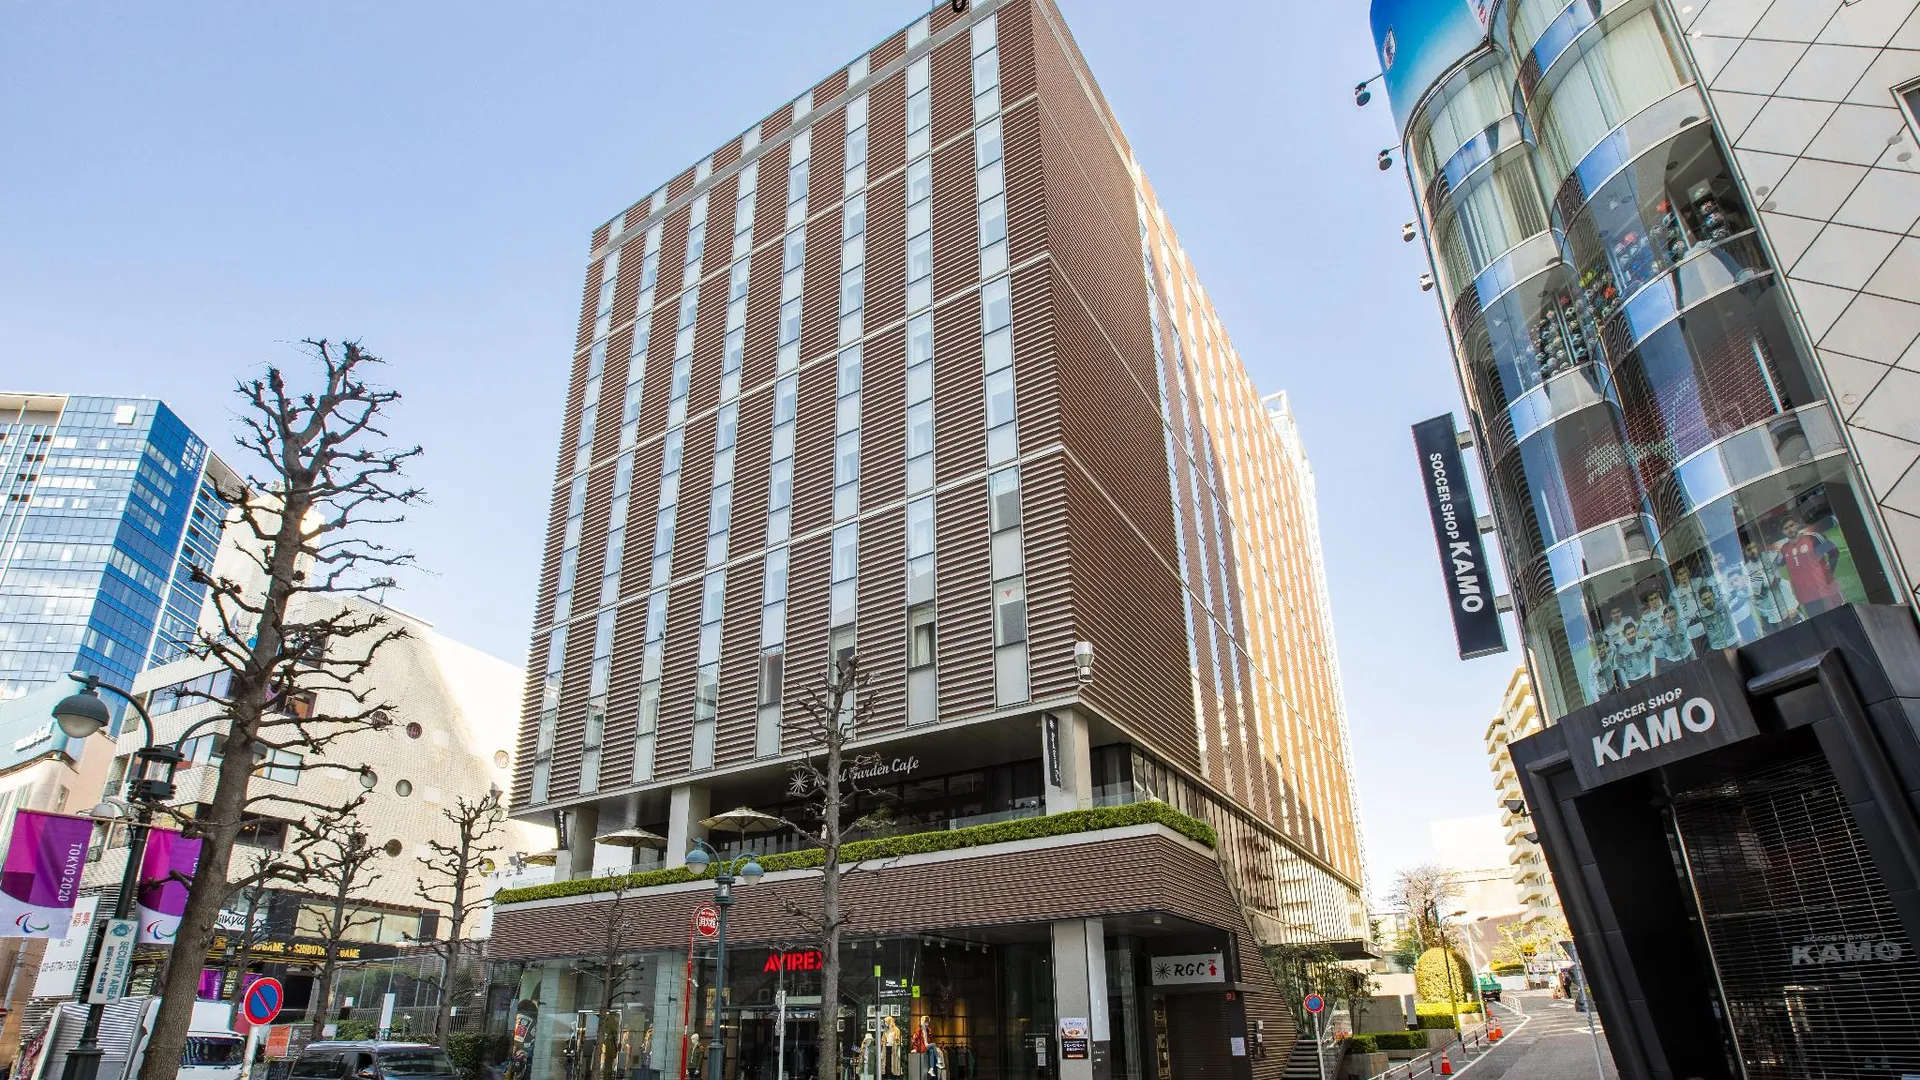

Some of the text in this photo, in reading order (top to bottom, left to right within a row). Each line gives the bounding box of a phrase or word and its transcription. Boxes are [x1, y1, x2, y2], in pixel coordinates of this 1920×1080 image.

[1429, 452, 1484, 613] SOCCER SHOP KAMO
[1601, 687, 1682, 728] SOCCER SHOP
[1592, 697, 1716, 767] KAMO
[891, 756, 919, 774] Cafe
[58, 842, 82, 902] TOKYO 2020
[106, 940, 129, 1000] SECURITY AREA
[763, 951, 823, 973] AVIREX
[1174, 963, 1206, 977] RGC
[1792, 941, 1902, 966] KAMO
